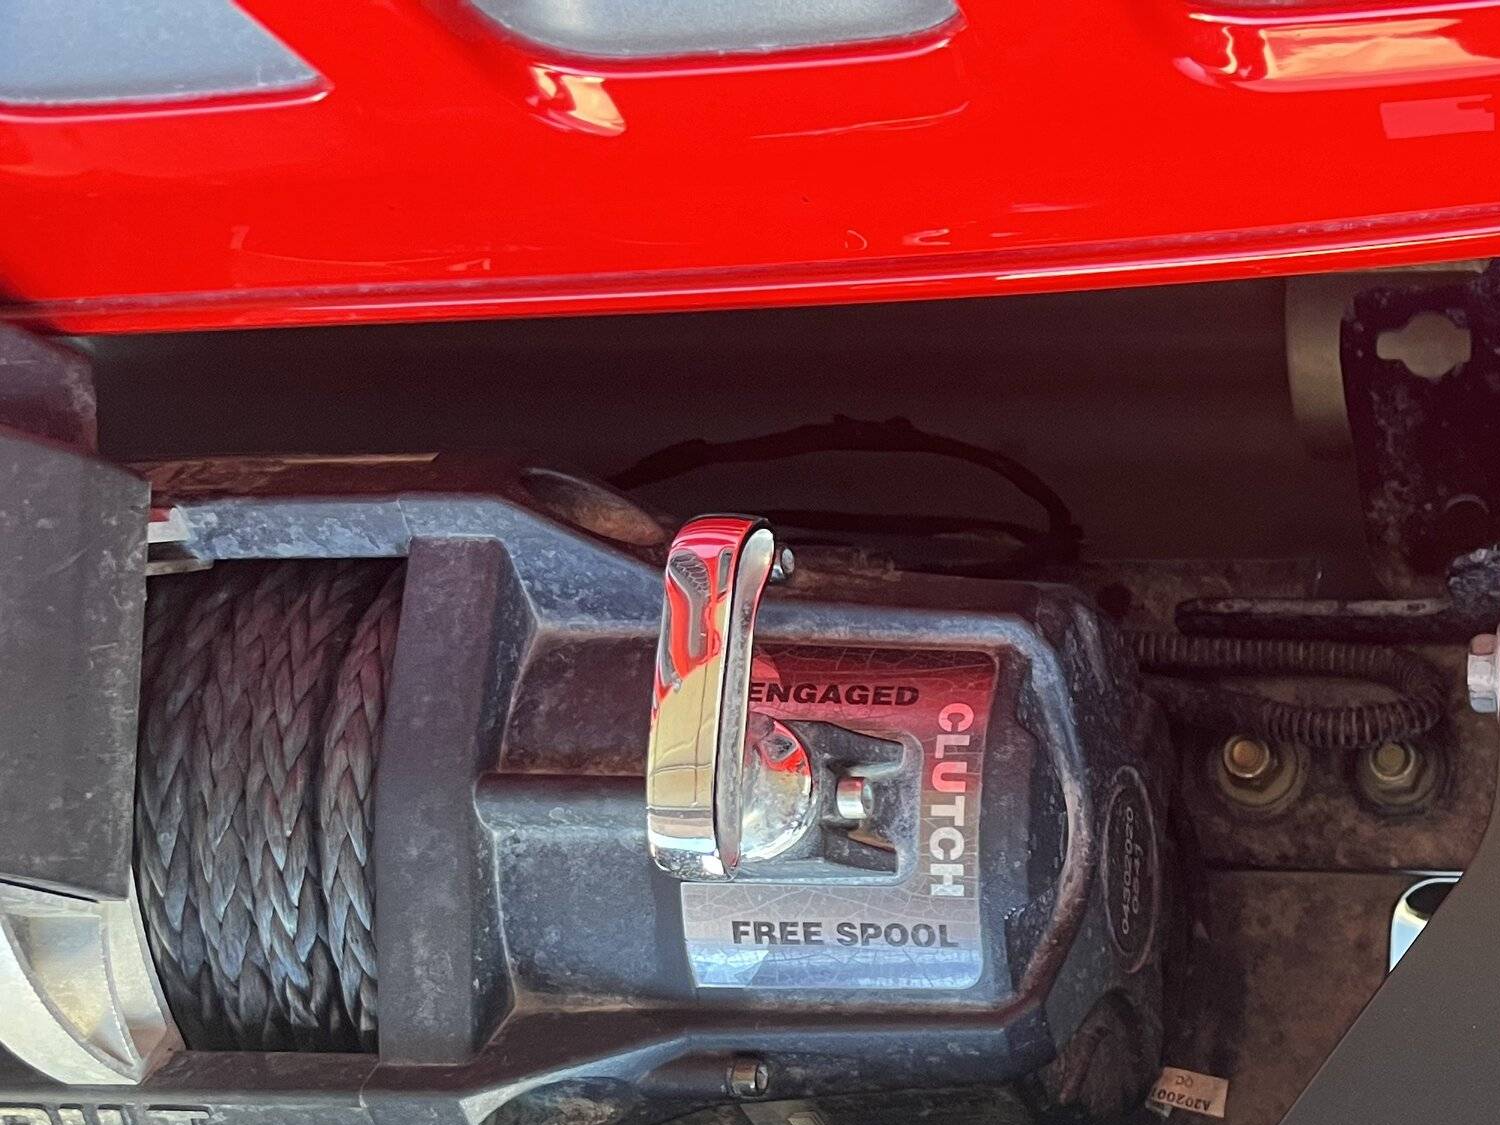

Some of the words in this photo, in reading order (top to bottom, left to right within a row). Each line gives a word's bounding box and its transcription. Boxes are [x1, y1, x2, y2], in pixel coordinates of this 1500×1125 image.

[749, 683, 919, 706] ENGAGED
[929, 703, 975, 896] CLUTCH
[732, 921, 824, 944] FREE
[836, 922, 959, 948] SPOOL
